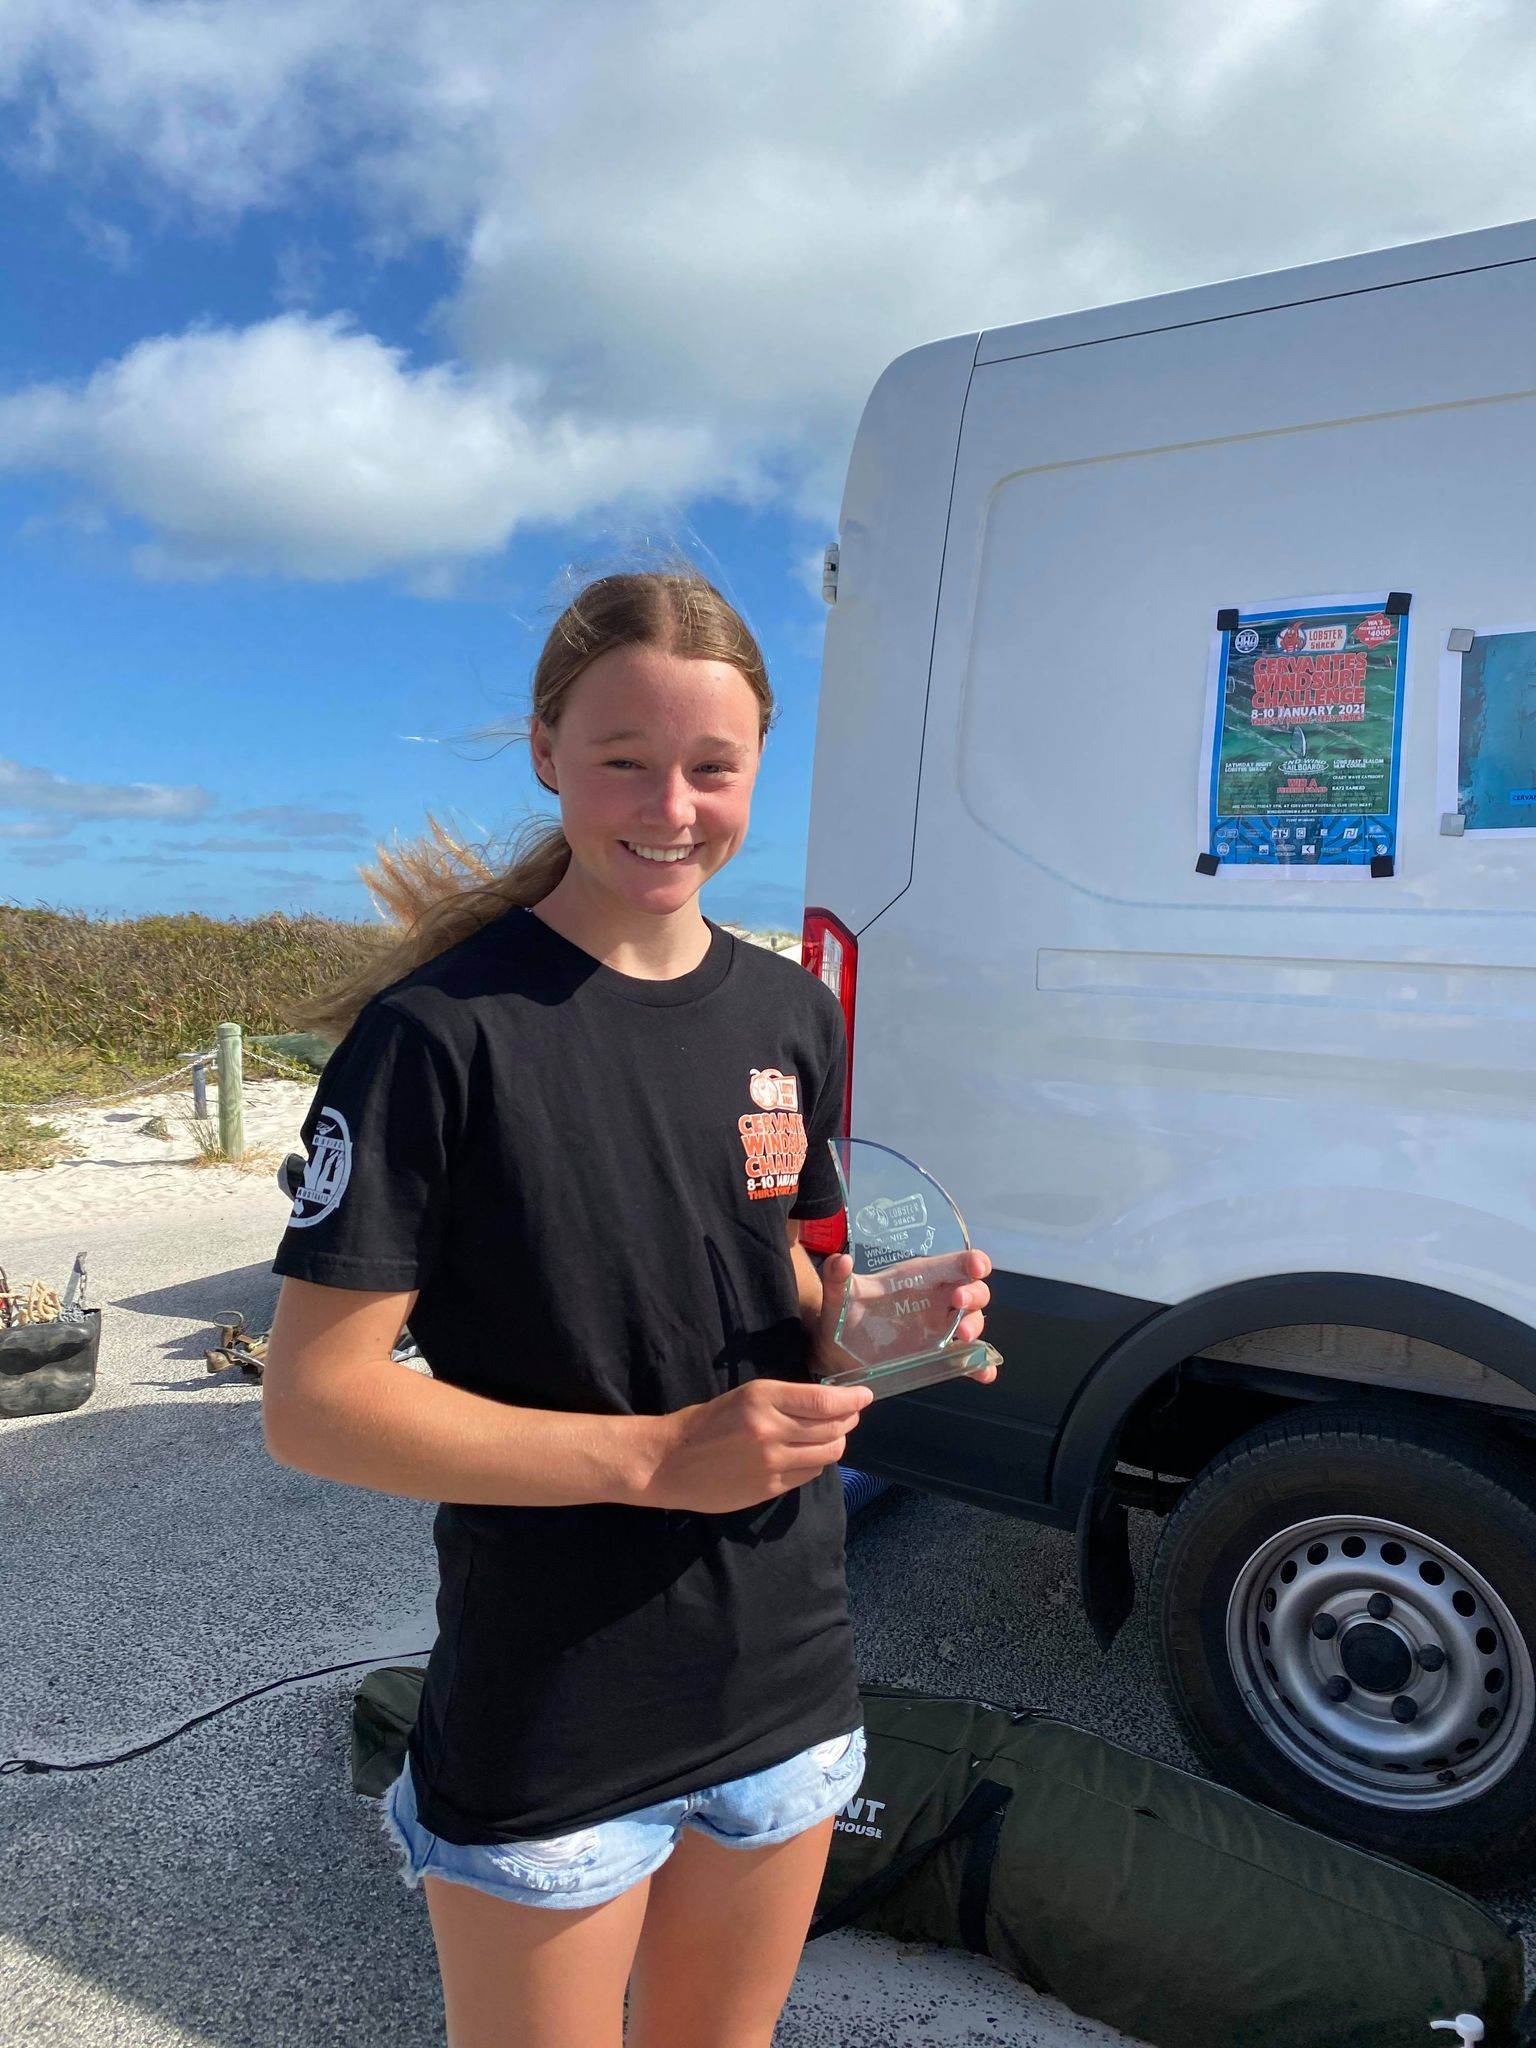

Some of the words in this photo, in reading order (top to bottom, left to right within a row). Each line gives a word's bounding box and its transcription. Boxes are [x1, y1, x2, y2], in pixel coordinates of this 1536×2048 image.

[1308, 629, 1344, 641] LOBSTER
[1310, 641, 1336, 650] SHACK
[1253, 653, 1368, 674] CERVANTES
[1254, 668, 1366, 692] WINDSURF
[1251, 688, 1365, 709] CHALLENGE
[1251, 707, 1275, 719] 8-10
[1277, 705, 1335, 718] JANUARY
[1338, 703, 1365, 715] 2021
[746, 1176, 775, 1191] 8-10
[889, 1203, 919, 1218] LOBSTER
[893, 1215, 916, 1227] SHACK
[867, 1249, 917, 1268] CHALLENGE
[889, 1273, 925, 1291] Iron
[894, 1297, 931, 1317] Man
